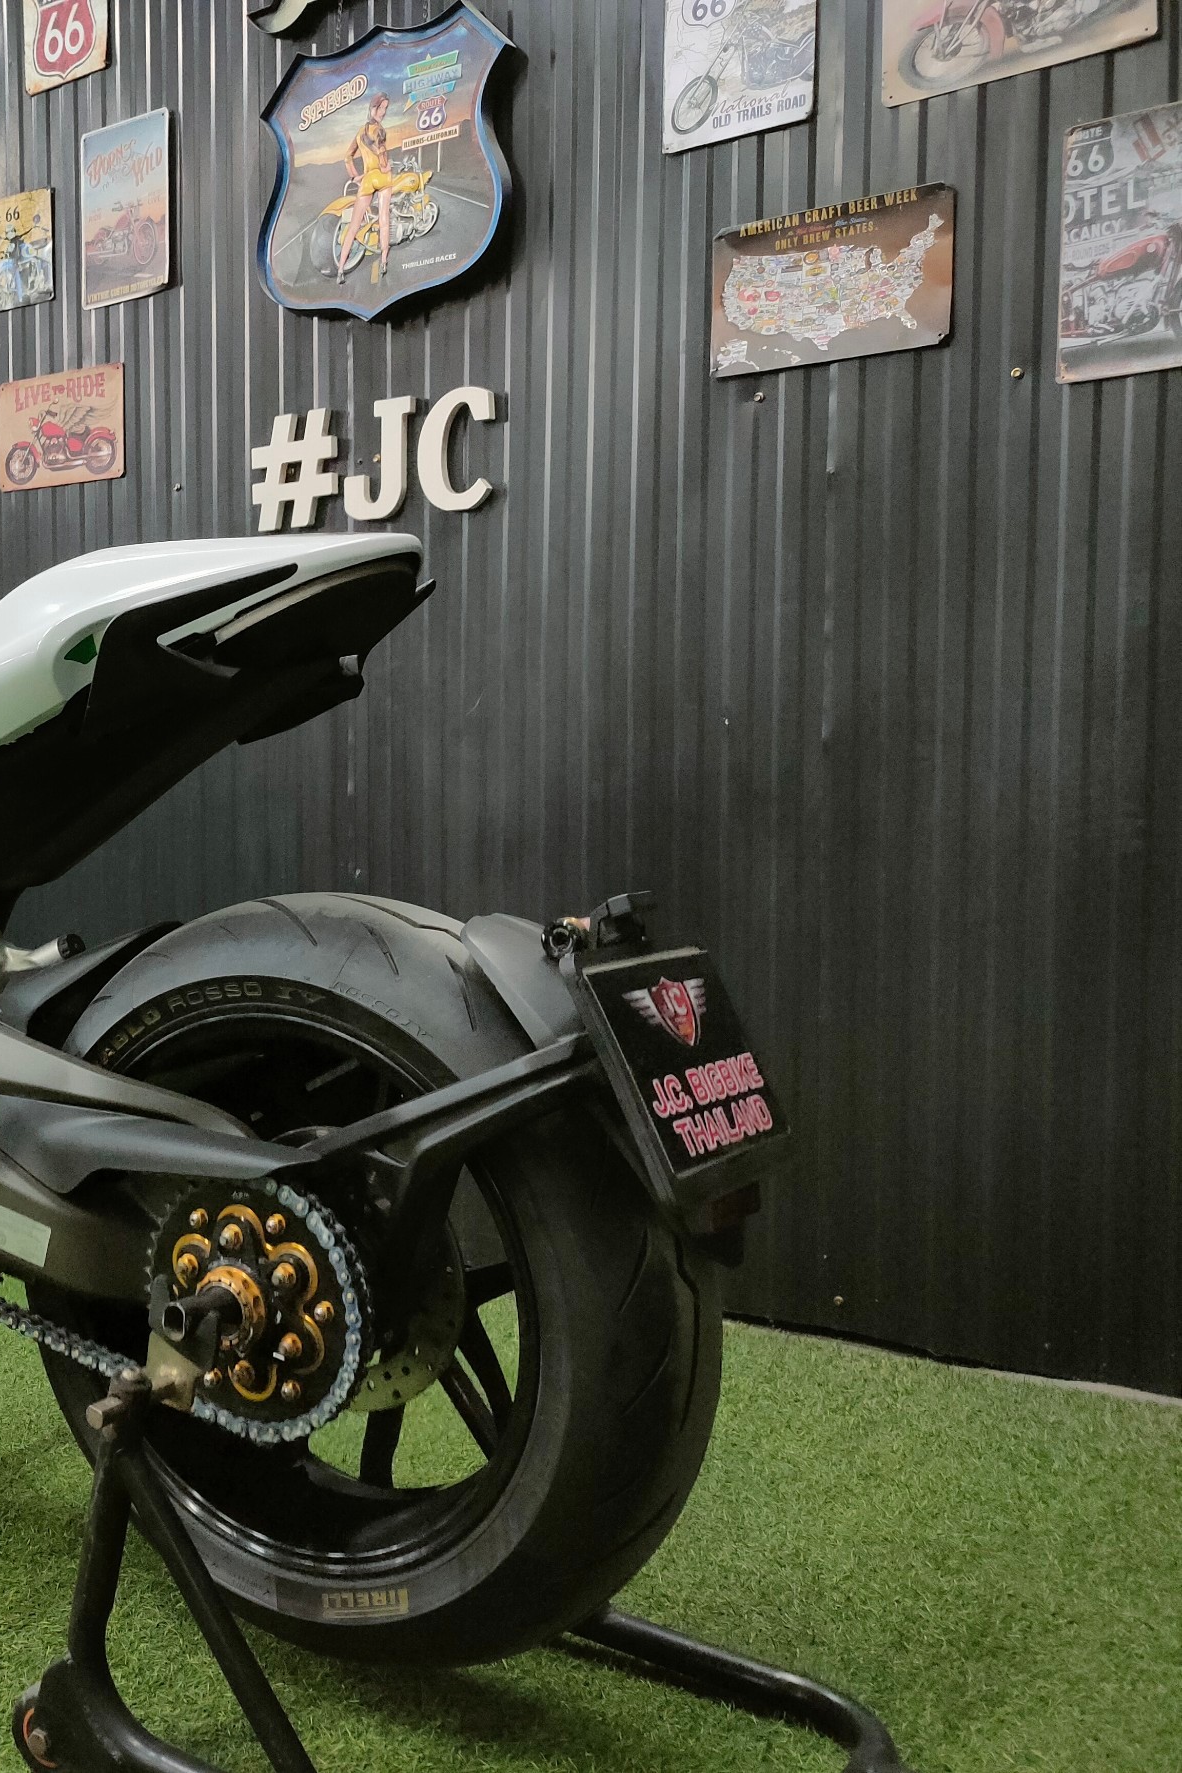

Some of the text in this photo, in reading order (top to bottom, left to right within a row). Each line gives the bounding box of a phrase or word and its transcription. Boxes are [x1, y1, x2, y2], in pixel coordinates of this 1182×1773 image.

[43, 2, 84, 63] 66
[405, 68, 458, 91] HIGHWAY
[299, 74, 368, 131] SPEED
[421, 98, 442, 109] ROUTE
[711, 80, 791, 117] National
[712, 94, 806, 129] OLD TRAILS ROAD
[419, 107, 442, 129] 66
[1067, 144, 1105, 177] 66
[5, 205, 20, 222] 66
[739, 188, 918, 237] AMERICAN CRAFT BEER WEEK
[775, 236, 798, 251] ONLY
[802, 231, 830, 245] BREW
[435, 253, 457, 263] RACES
[14, 372, 106, 412] LIVE TO RIDE
[251, 386, 496, 532] #JC
[168, 981, 263, 1013] ROSSO
[661, 987, 687, 1016] JC
[652, 1052, 764, 1118] J.C. BIGBIKE
[673, 1094, 773, 1157] THAILAND
[322, 1587, 409, 1619] PIRELLI
